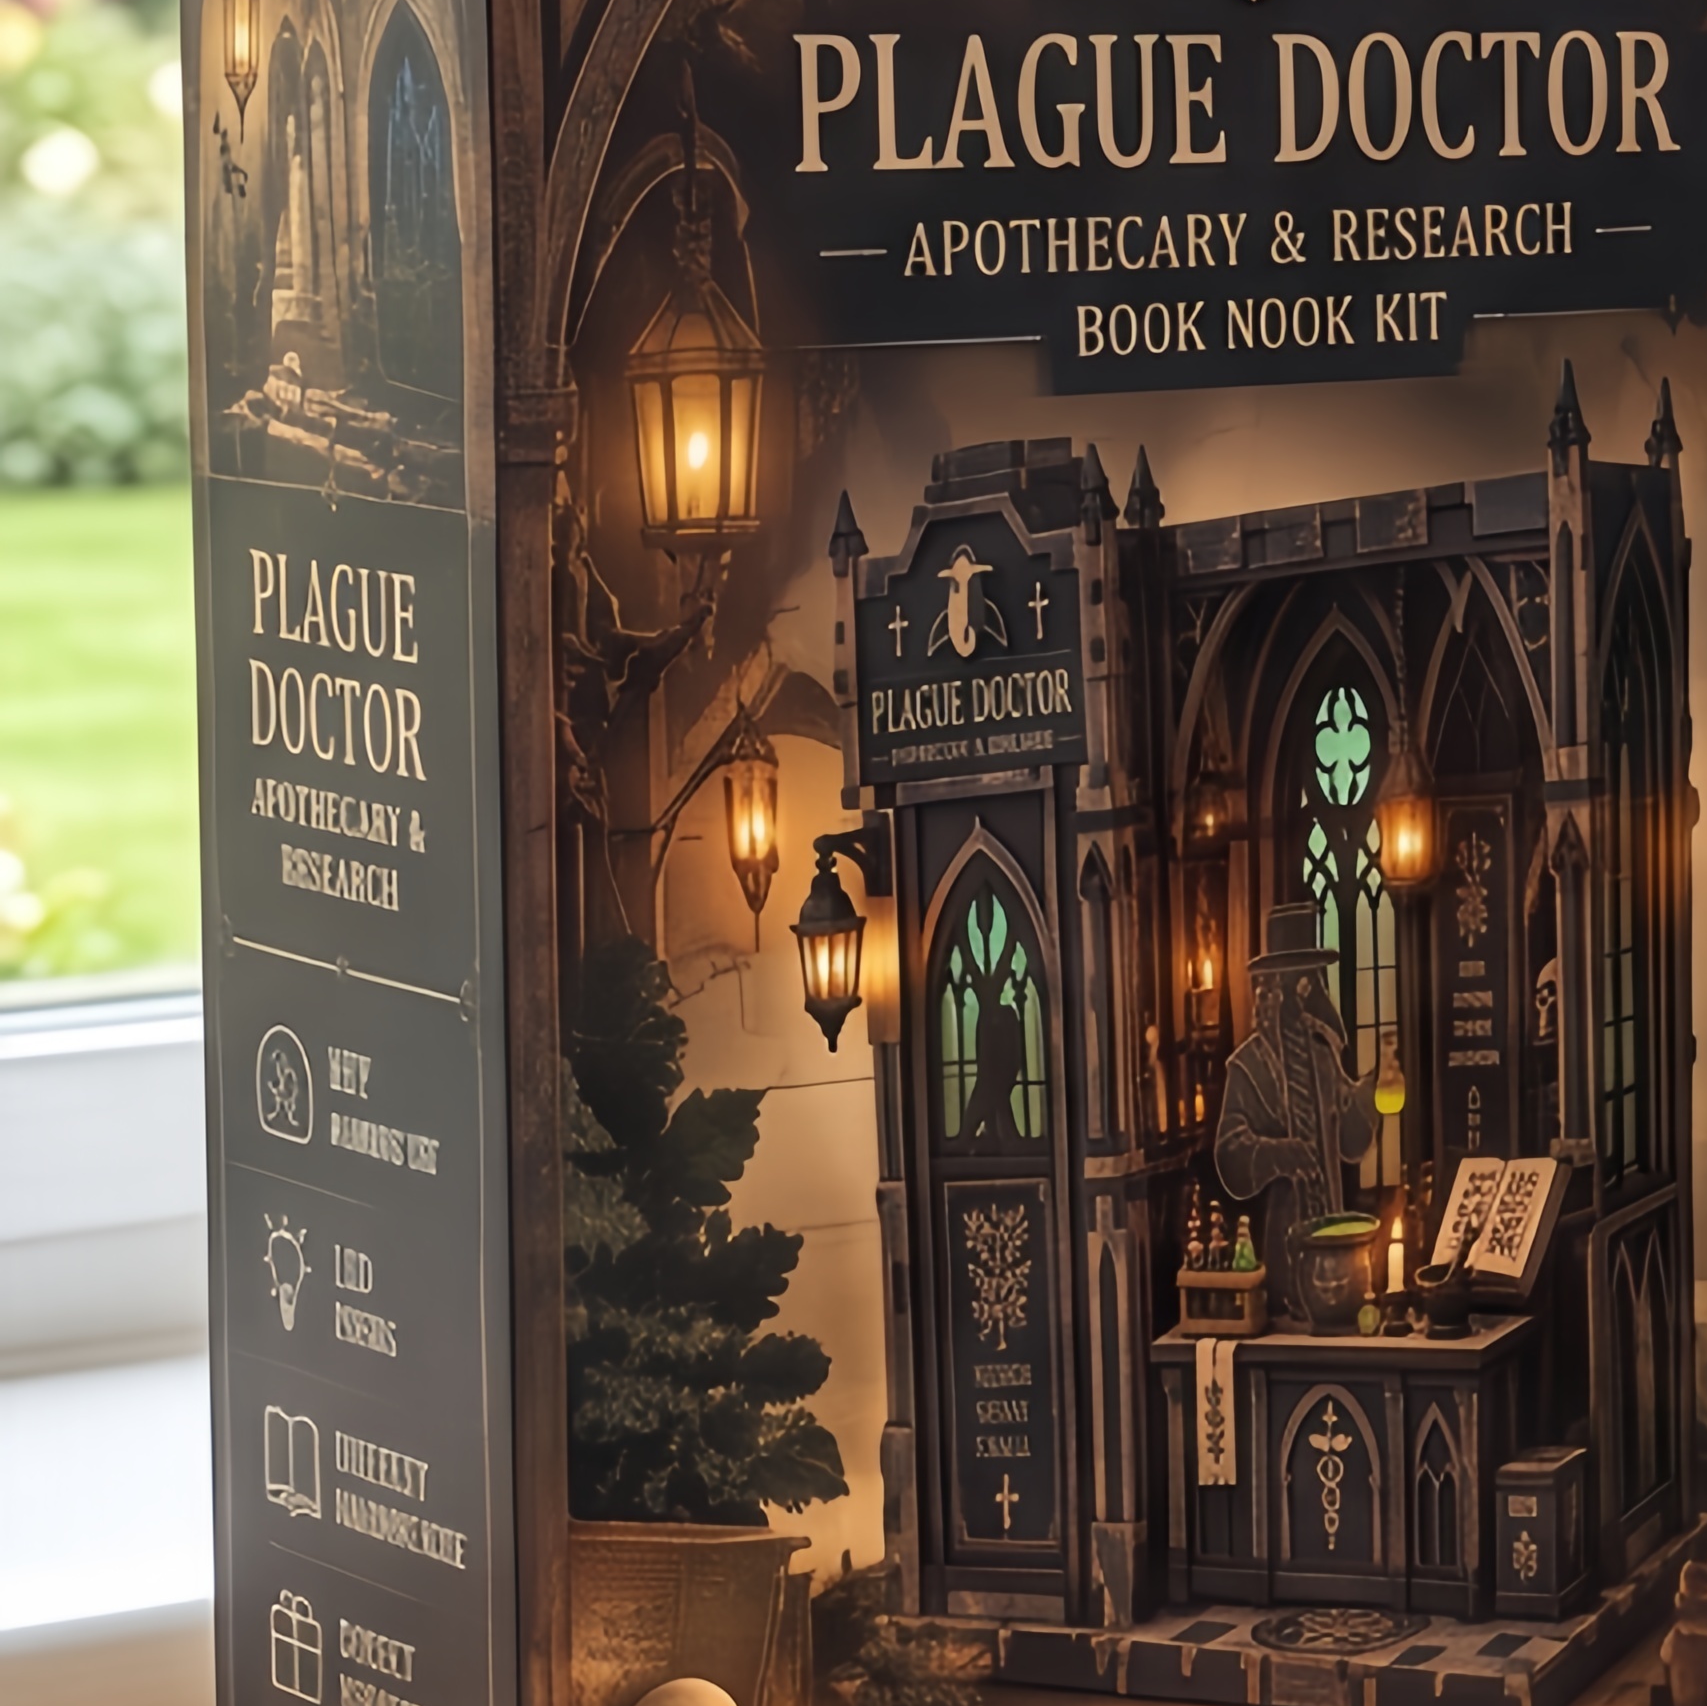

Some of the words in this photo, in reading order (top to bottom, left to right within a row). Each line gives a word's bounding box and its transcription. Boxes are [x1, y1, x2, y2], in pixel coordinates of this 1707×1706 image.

[793, 32, 1227, 173] PLAGUE
[1273, 29, 1681, 164] DOCTOR
[904, 212, 1248, 277] APOTHECARY
[1269, 209, 1307, 265] &
[1332, 202, 1574, 263] RESEARCH
[1075, 300, 1208, 358] BOOK
[1225, 294, 1355, 350] NOOK
[1373, 291, 1448, 343] KIT
[249, 548, 418, 664] PLAGUE
[249, 659, 427, 781] DOCTOR
[872, 681, 964, 734] PLAGUE
[972, 669, 1072, 722] DOCTOR
